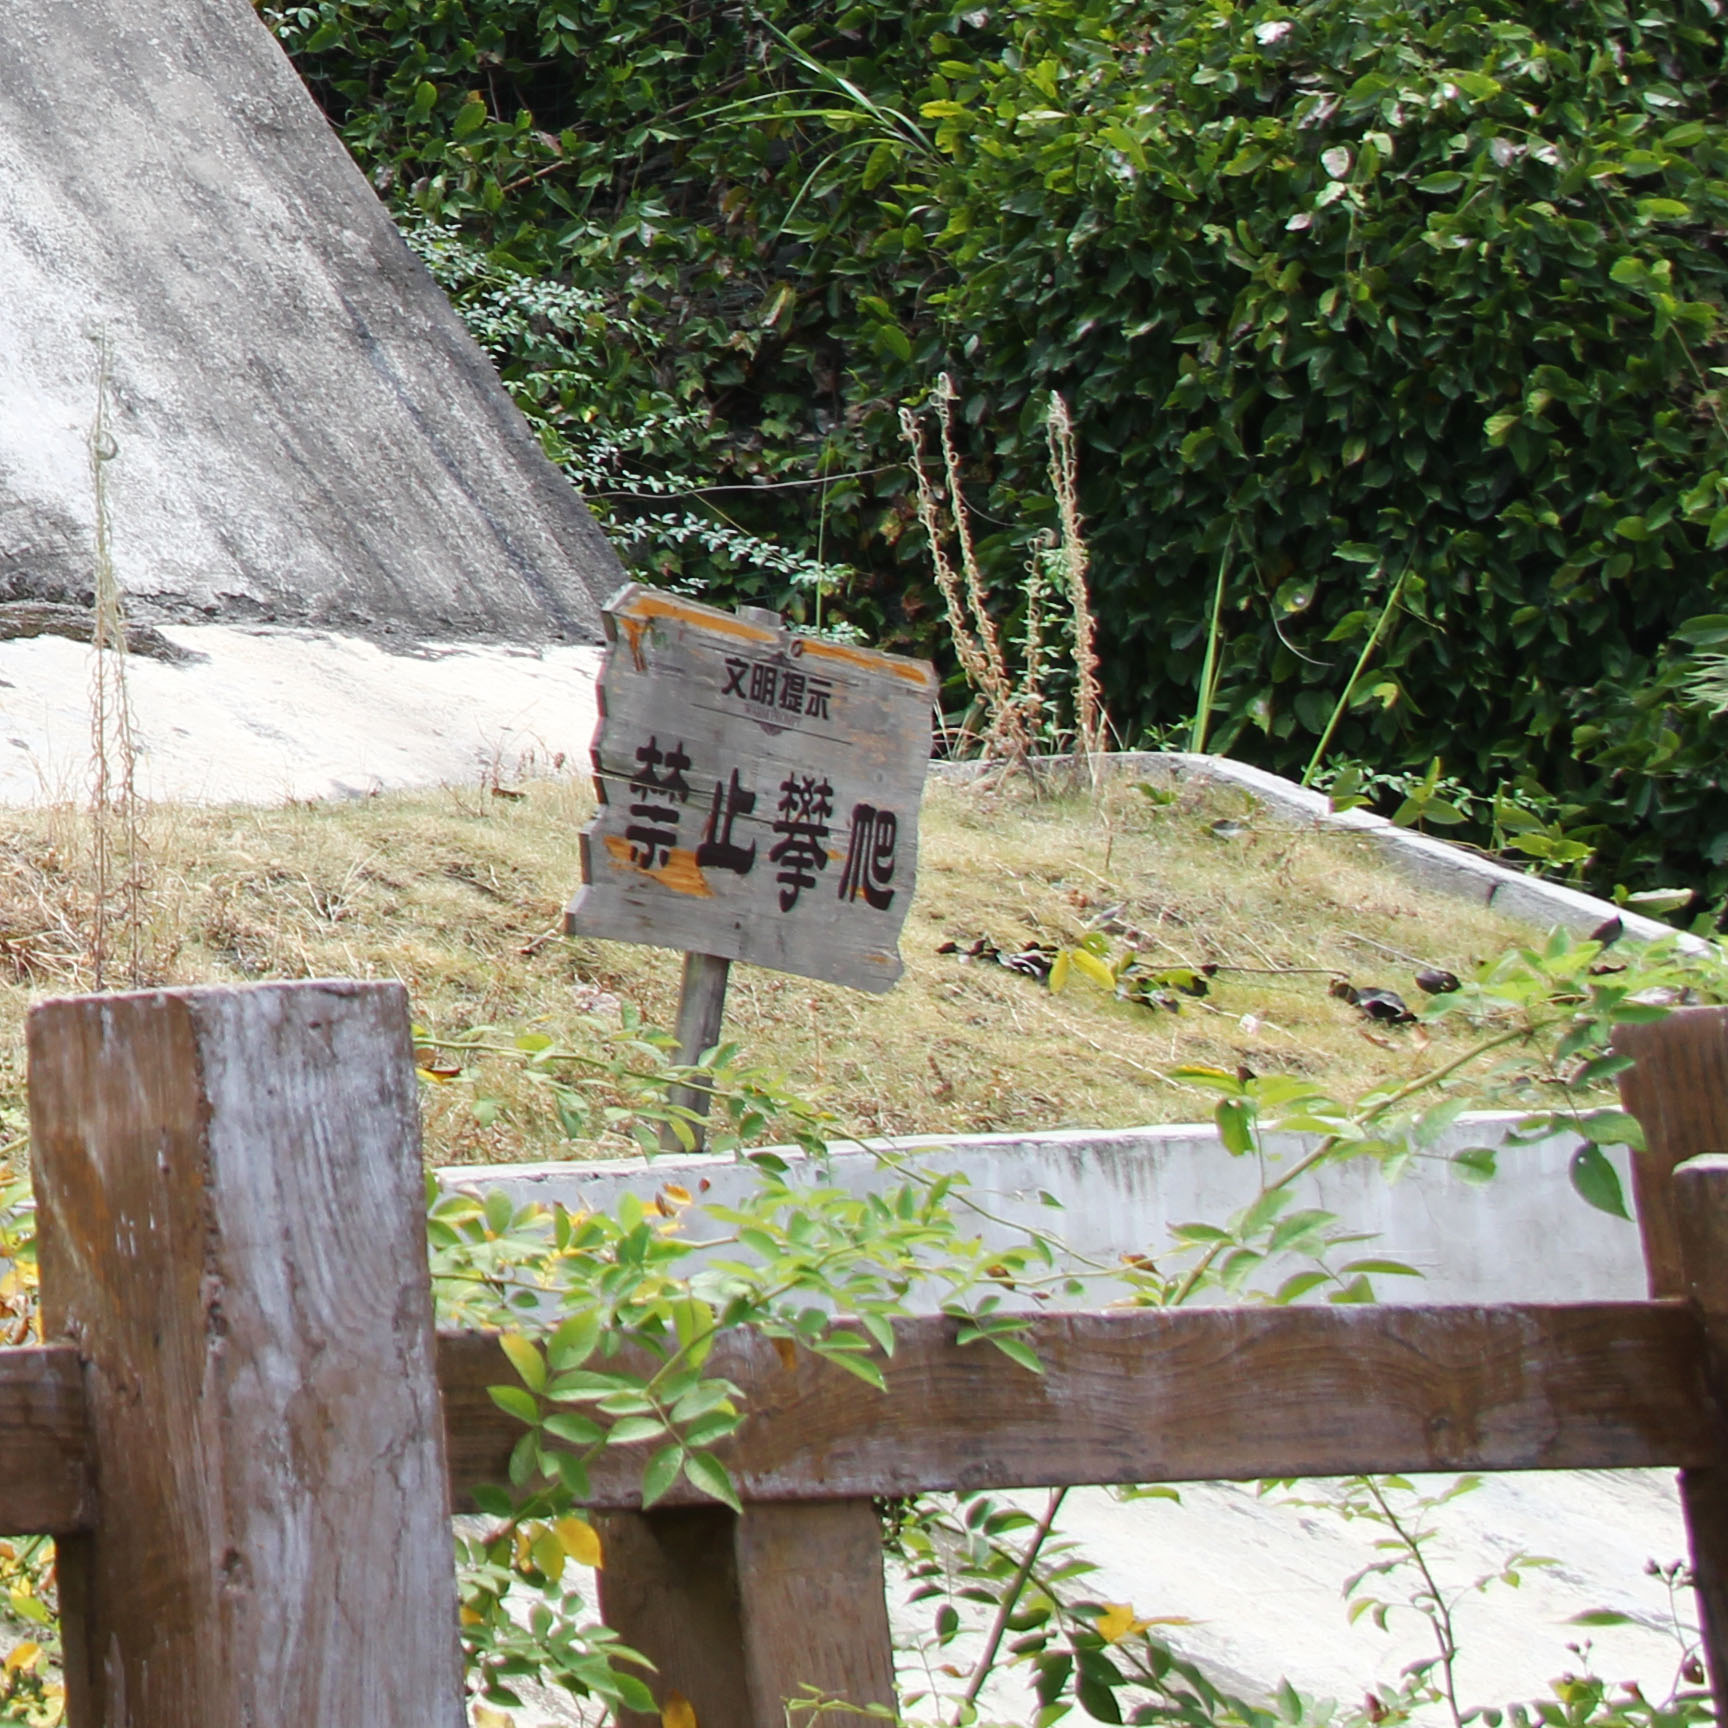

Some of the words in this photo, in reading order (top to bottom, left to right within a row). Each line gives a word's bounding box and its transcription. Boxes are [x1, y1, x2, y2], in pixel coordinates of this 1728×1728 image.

[721, 657, 832, 720] 文明提示
[625, 736, 897, 913] 禁止攀爬
